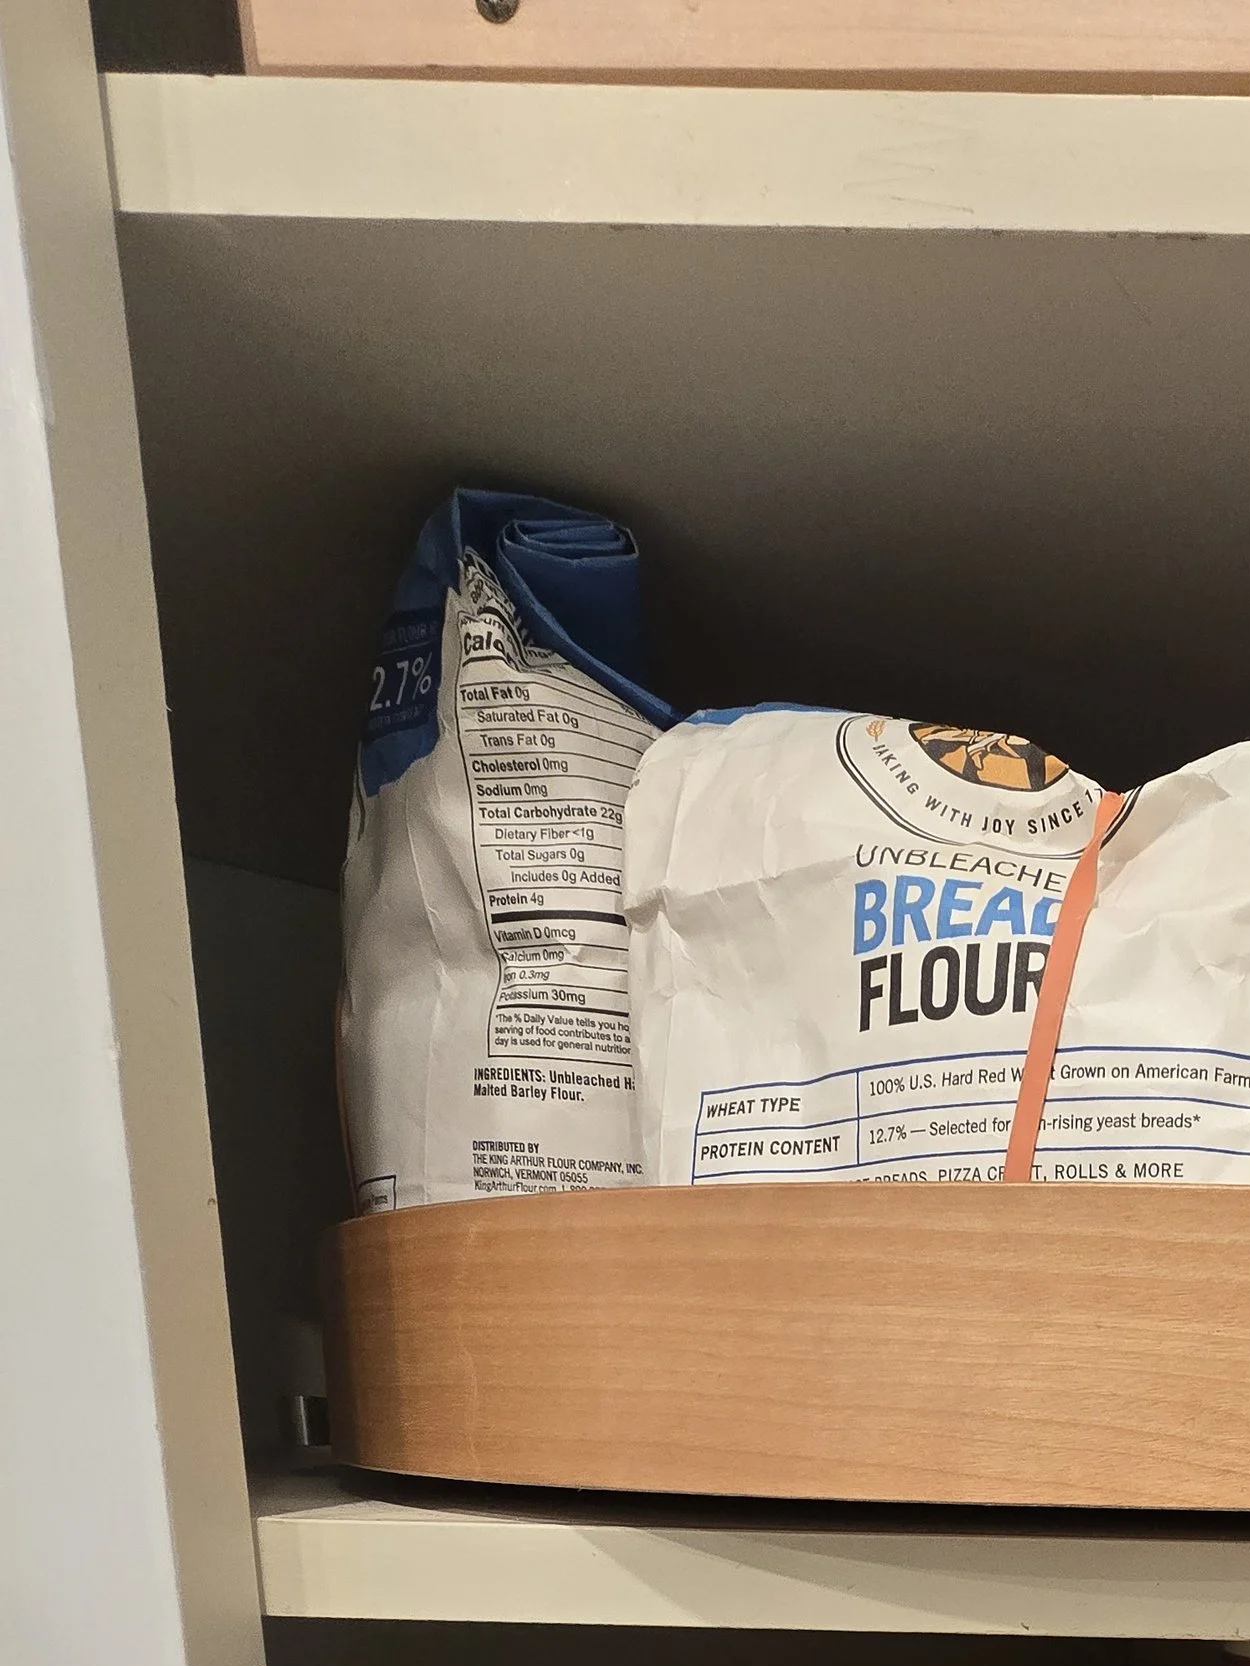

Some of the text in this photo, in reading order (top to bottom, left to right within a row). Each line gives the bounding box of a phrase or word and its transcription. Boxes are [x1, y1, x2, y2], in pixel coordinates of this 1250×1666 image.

[460, 688, 530, 701] Total Fat 0g
[477, 710, 578, 728] Saturated Fat 0g
[480, 733, 555, 748] Trans Fat 0g
[472, 758, 568, 772] Cholesterol 0mg
[476, 783, 548, 797] Sodium 0mg
[479, 805, 623, 824] Total Carbohydrate 22g
[925, 795, 973, 827] WITH
[982, 819, 1015, 835] JOY
[1028, 801, 1083, 834] SINCE
[495, 828, 536, 842] Dietary
[496, 848, 585, 862] Total Sugars 0g
[857, 844, 1067, 892] UNBLEACHE
[511, 871, 620, 886] Includes 0g Added
[489, 892, 544, 907] Protein 4g
[494, 927, 576, 942] Vitamin D 0mcg
[543, 950, 564, 961] 0mg
[519, 970, 550, 981] 0.3mg
[860, 942, 1051, 1032] FLOUR
[552, 990, 585, 1004] 30mg
[474, 1068, 546, 1082] INGREDIENTS:
[550, 1070, 620, 1088] Unbleached
[870, 1079, 905, 1096] 100%
[909, 1074, 936, 1090] U.S.
[942, 1070, 973, 1087] Hard
[979, 1068, 1005, 1082] Red
[1061, 1065, 1105, 1079] Grown
[1112, 1067, 1129, 1079] on
[1136, 1064, 1208, 1081] American
[474, 1084, 584, 1101] Malted Barley Flour.
[707, 1098, 801, 1118] WHEAT TYPE
[870, 1125, 906, 1144] 12.7%
[930, 1118, 987, 1137] Selected
[993, 1117, 1011, 1132] for
[1097, 1114, 1136, 1131] yeast
[473, 1141, 539, 1153] DISTRIBUTED BY
[701, 1136, 840, 1160] PROTEIN CONTENT
[473, 1154, 643, 1174] THE KING ARTHUR FLOUR COMPANY, INC.
[473, 1168, 588, 1183] NORWICH, VERMONT 05055
[938, 1167, 979, 1182] PIZZA
[1055, 1164, 1108, 1179] ROLLS
[1115, 1164, 1126, 1178] &
[1134, 1163, 1183, 1178] MORE
